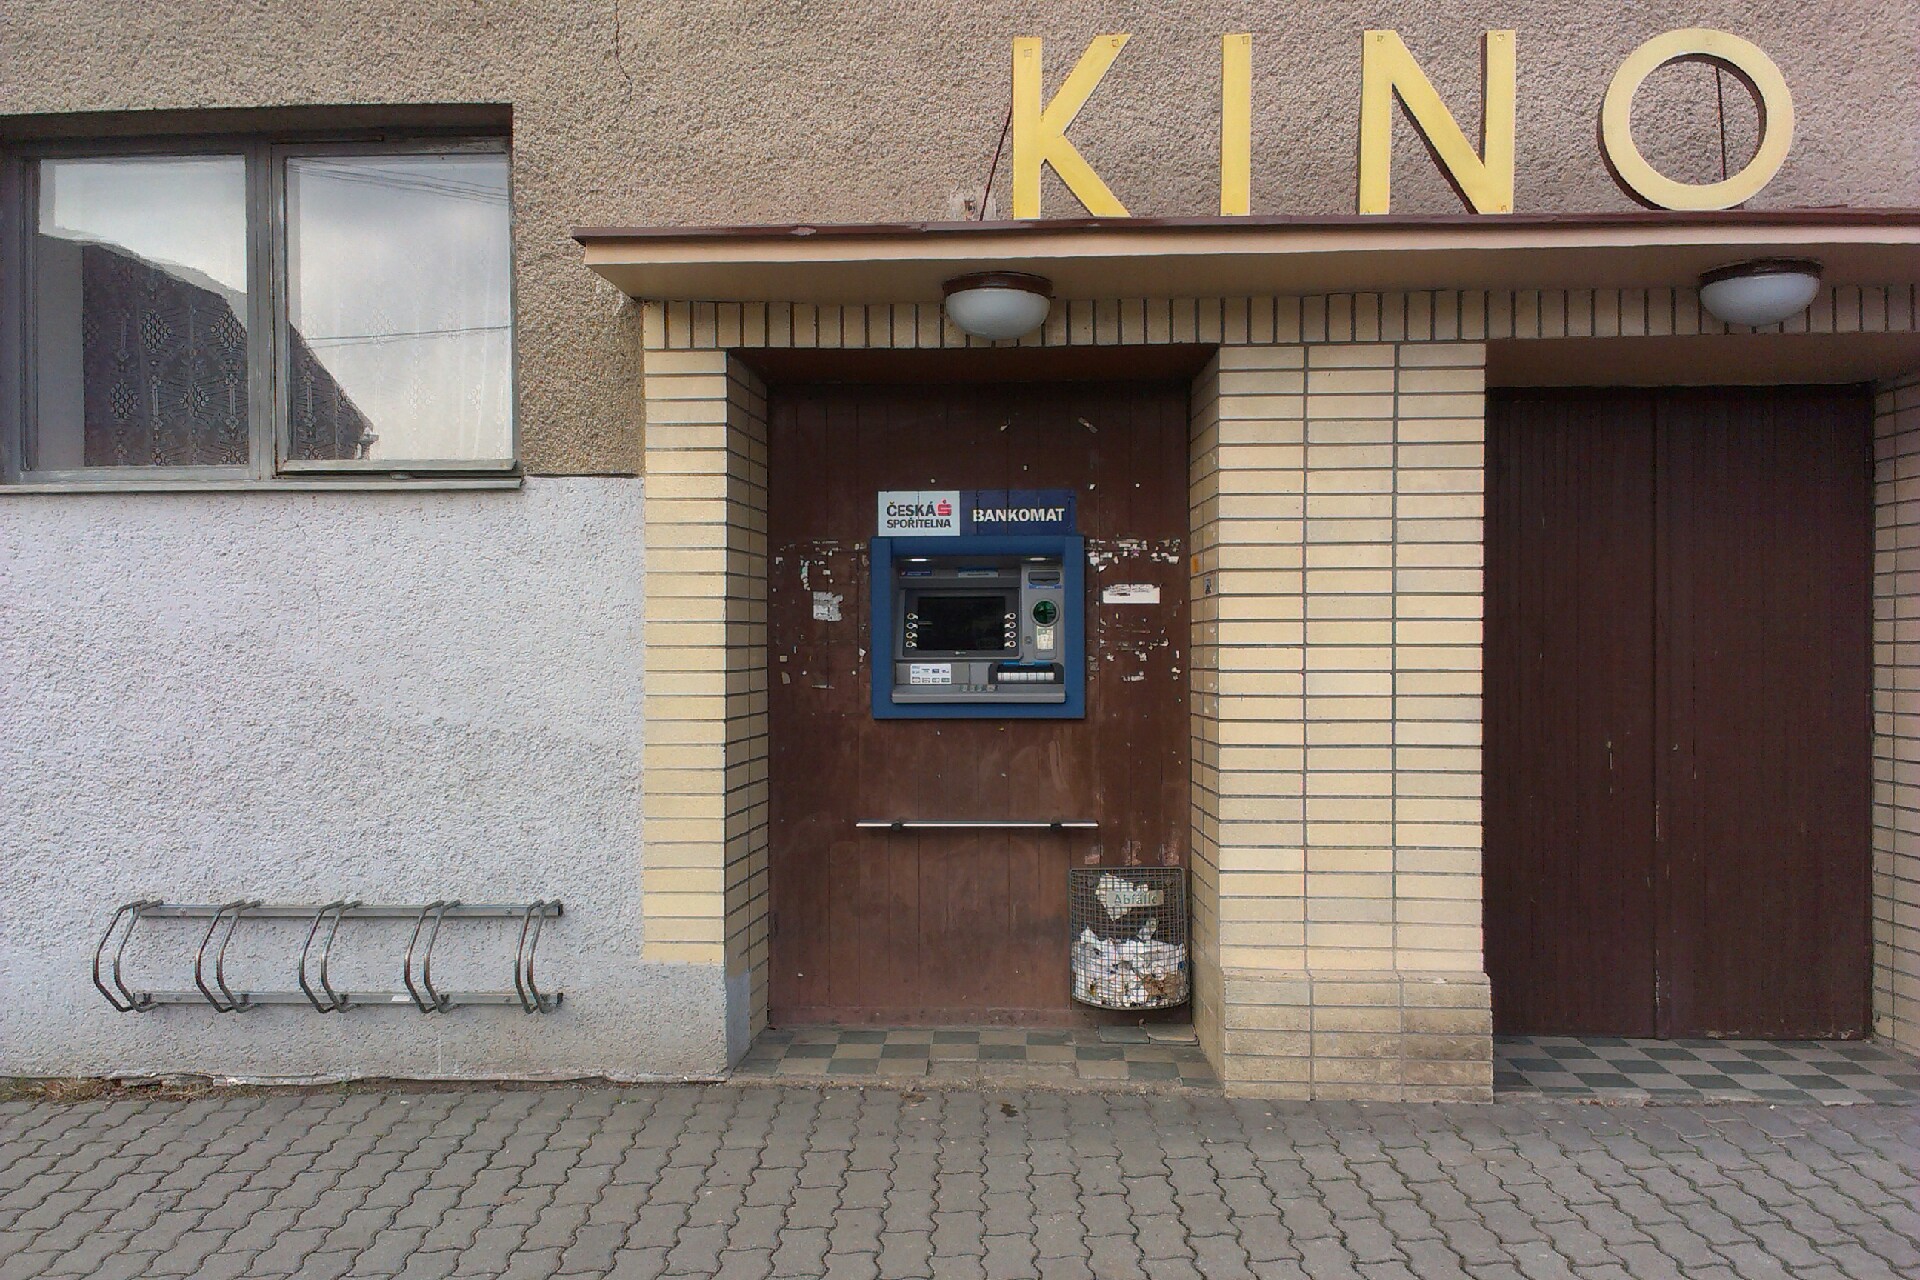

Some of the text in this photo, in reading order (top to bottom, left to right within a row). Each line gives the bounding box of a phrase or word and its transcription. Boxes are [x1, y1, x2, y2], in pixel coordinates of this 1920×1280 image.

[1012, 28, 1795, 218] KINO
[886, 501, 936, 516] ČESKÁ
[972, 508, 1065, 522] BANKOMAT
[886, 517, 952, 528] SPOŘITELNA
